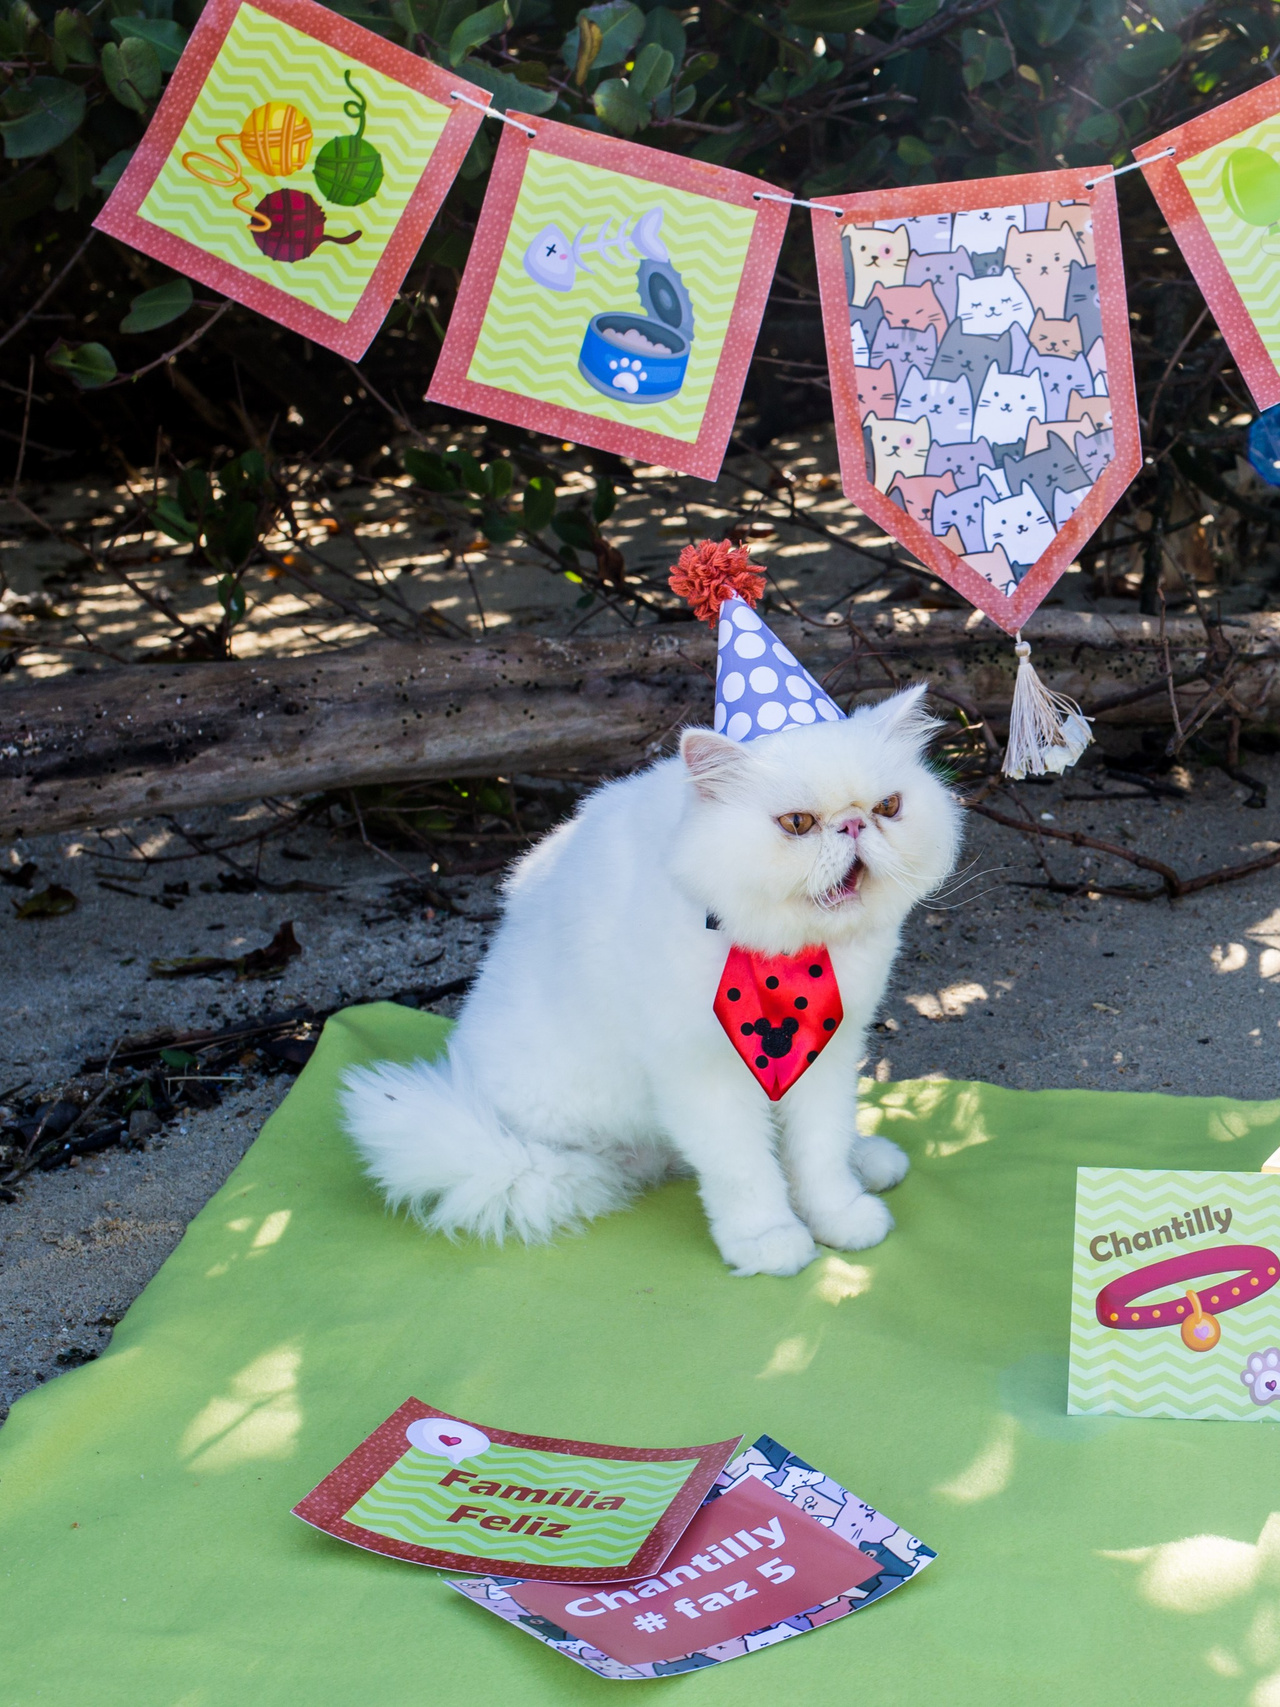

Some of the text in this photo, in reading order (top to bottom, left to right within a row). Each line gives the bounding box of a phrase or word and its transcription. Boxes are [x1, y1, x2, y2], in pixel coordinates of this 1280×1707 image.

[1089, 1205, 1233, 1262] Chantilly
[438, 1468, 627, 1511] Família
[446, 1504, 572, 1539] Feliz
[564, 1516, 787, 1618] Chantilly
[673, 1581, 758, 1620] faz
[756, 1556, 796, 1585] 5
